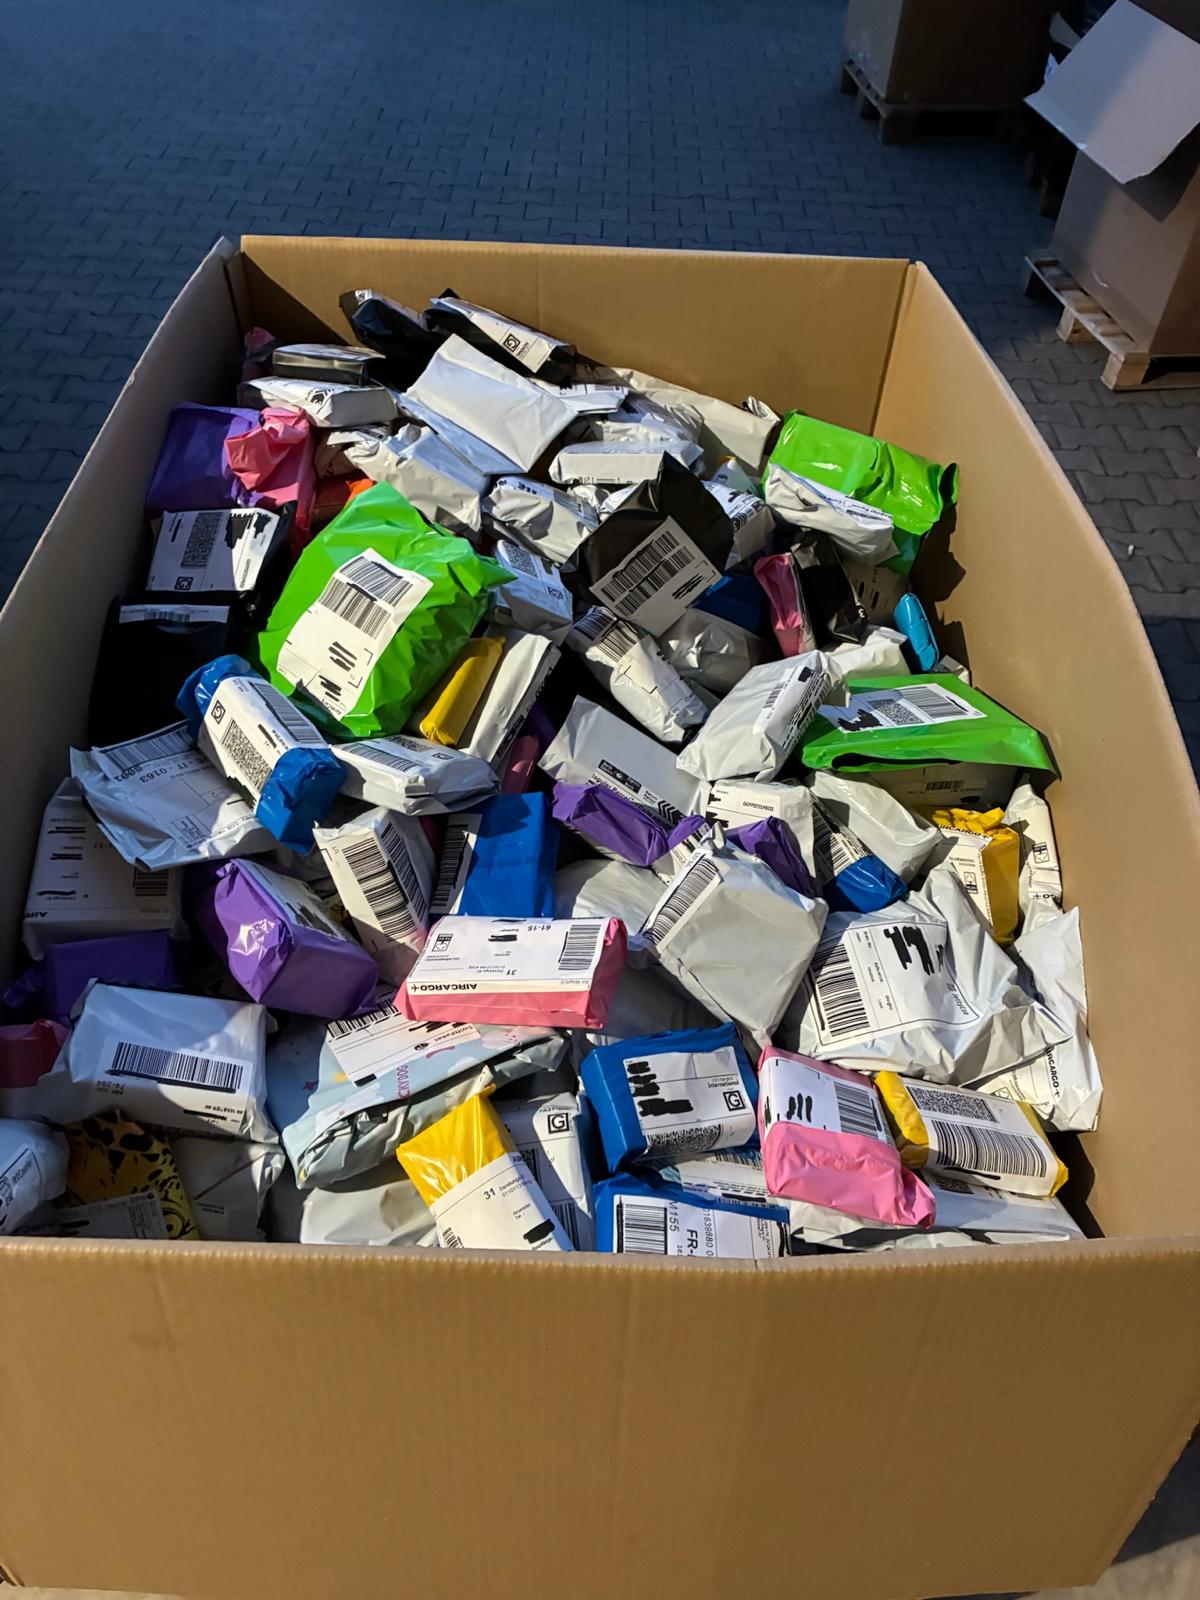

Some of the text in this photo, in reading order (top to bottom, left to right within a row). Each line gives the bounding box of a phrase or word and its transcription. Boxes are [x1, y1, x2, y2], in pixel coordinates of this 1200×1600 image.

[139, 767, 168, 783] 0163
[527, 924, 551, 932] 61-15
[420, 983, 477, 991] AIRCARGO
[484, 1188, 496, 1200] 31
[687, 1229, 698, 1256] FR-
